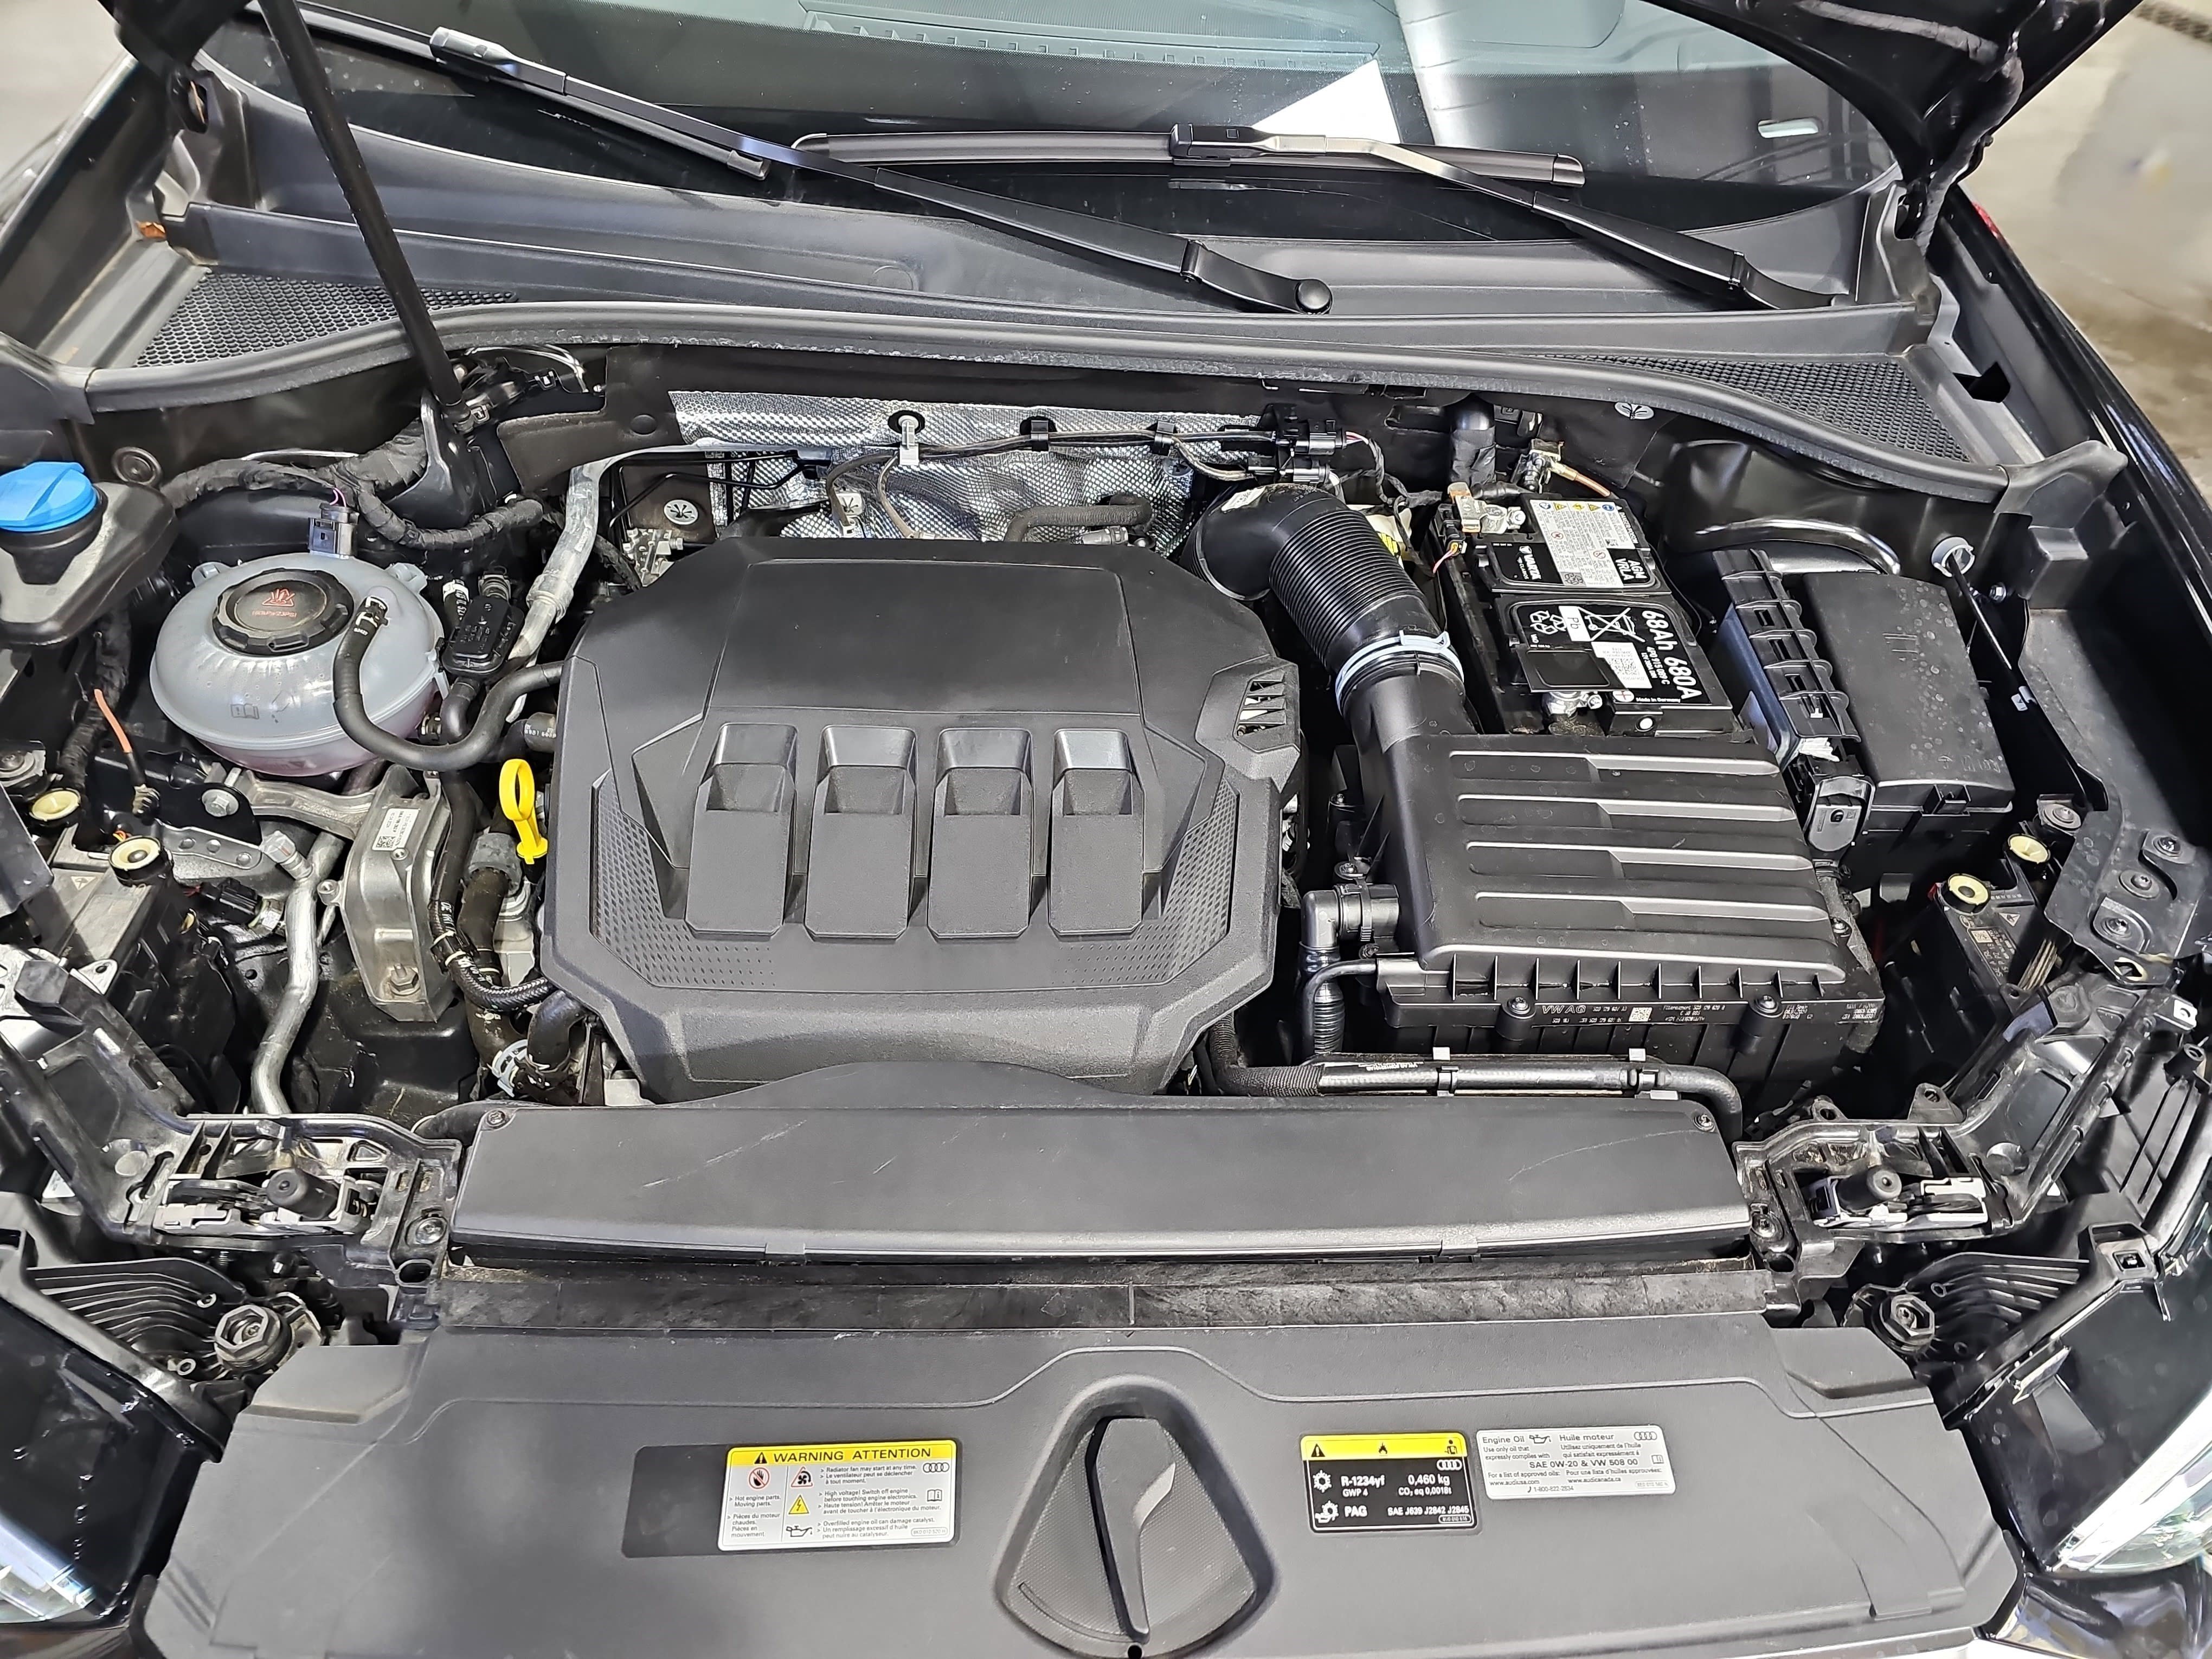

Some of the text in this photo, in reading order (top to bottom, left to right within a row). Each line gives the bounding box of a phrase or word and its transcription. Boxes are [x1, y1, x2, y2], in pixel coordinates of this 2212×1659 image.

[1520, 563, 1529, 580] CLARIOS
[1524, 554, 1542, 580] VARTA
[1615, 558, 1635, 581] VRLA
[1628, 560, 1648, 578] AGM
[1567, 617, 1580, 629] Pb
[1642, 610, 1702, 699] 68Ah 680A
[1652, 657, 1663, 668] 915
[1542, 1005, 1565, 1014] VW
[1565, 1005, 1586, 1014] AG
[1482, 1436, 1510, 1444] Engine
[774, 1448, 931, 1462] WARNING ATTENTION
[1341, 1474, 1450, 1488] R-1234yf 0,460 kg
[1342, 1487, 1452, 1497] GWP 4 eq 0,0018t
[1345, 1505, 1469, 1517] PAG SAE J639 J2842 J2845
